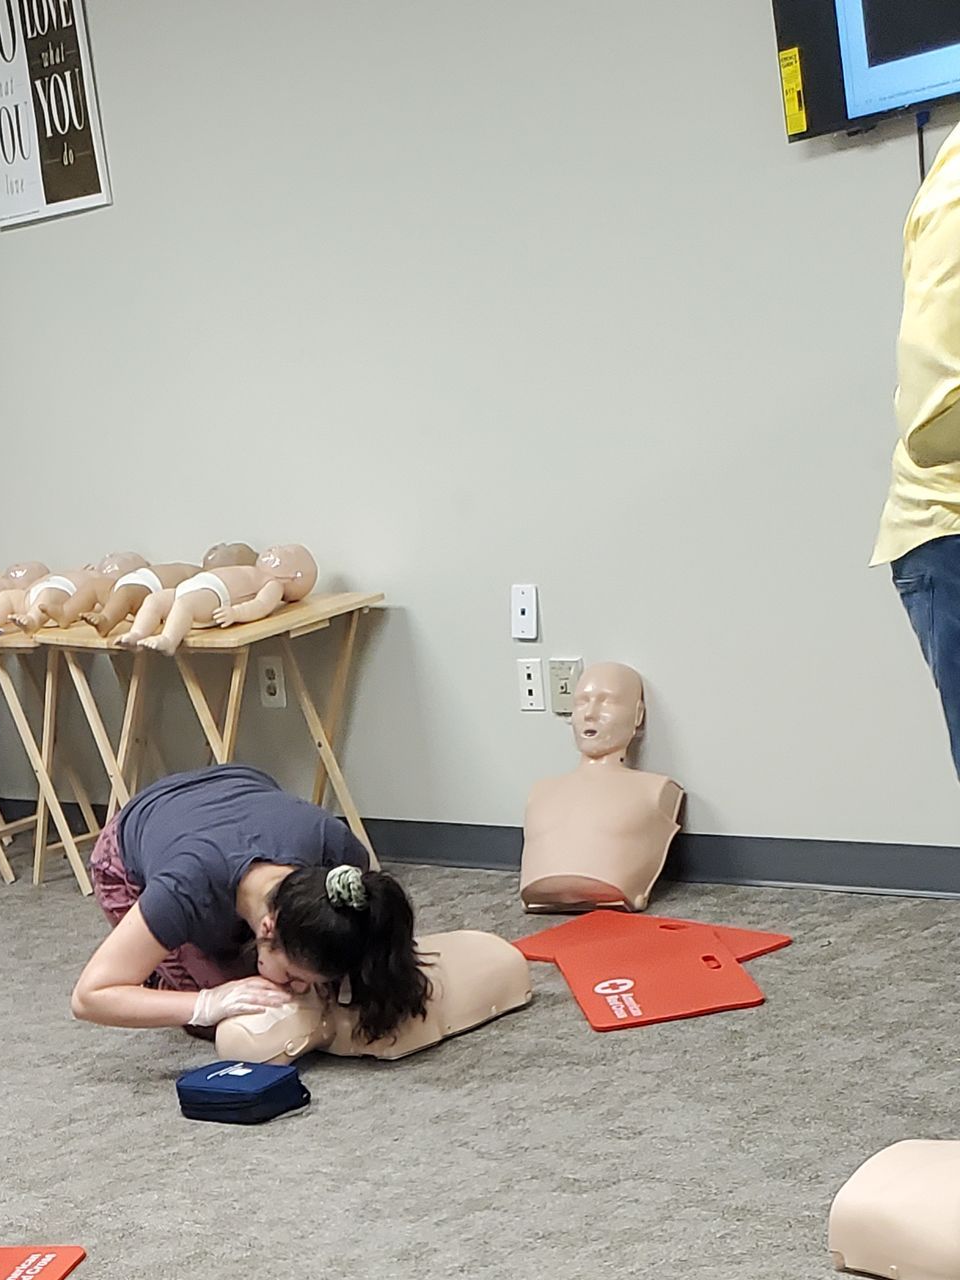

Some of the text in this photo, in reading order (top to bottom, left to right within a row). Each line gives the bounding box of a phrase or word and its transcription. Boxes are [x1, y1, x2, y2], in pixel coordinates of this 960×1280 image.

[41, 41, 65, 68] what
[34, 68, 85, 138] YOU
[62, 142, 75, 166] do
[25, 1252, 57, 1275] Cross
